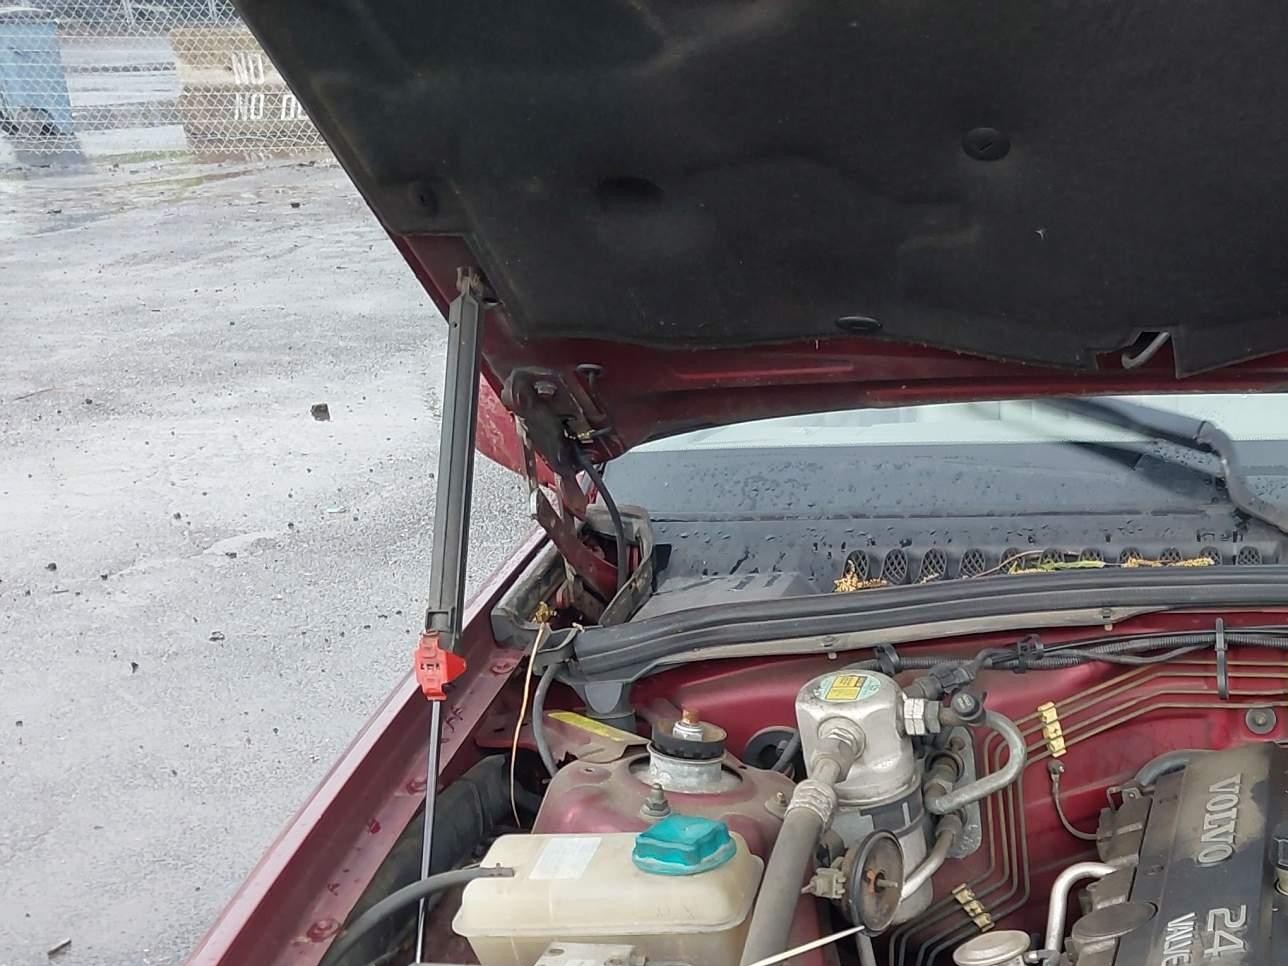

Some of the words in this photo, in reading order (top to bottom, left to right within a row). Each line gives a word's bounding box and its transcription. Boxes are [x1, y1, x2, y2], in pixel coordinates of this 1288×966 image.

[231, 53, 265, 84] NO
[234, 92, 265, 121] NO
[1198, 773, 1241, 866] VOLVO
[1203, 904, 1247, 959] 24
